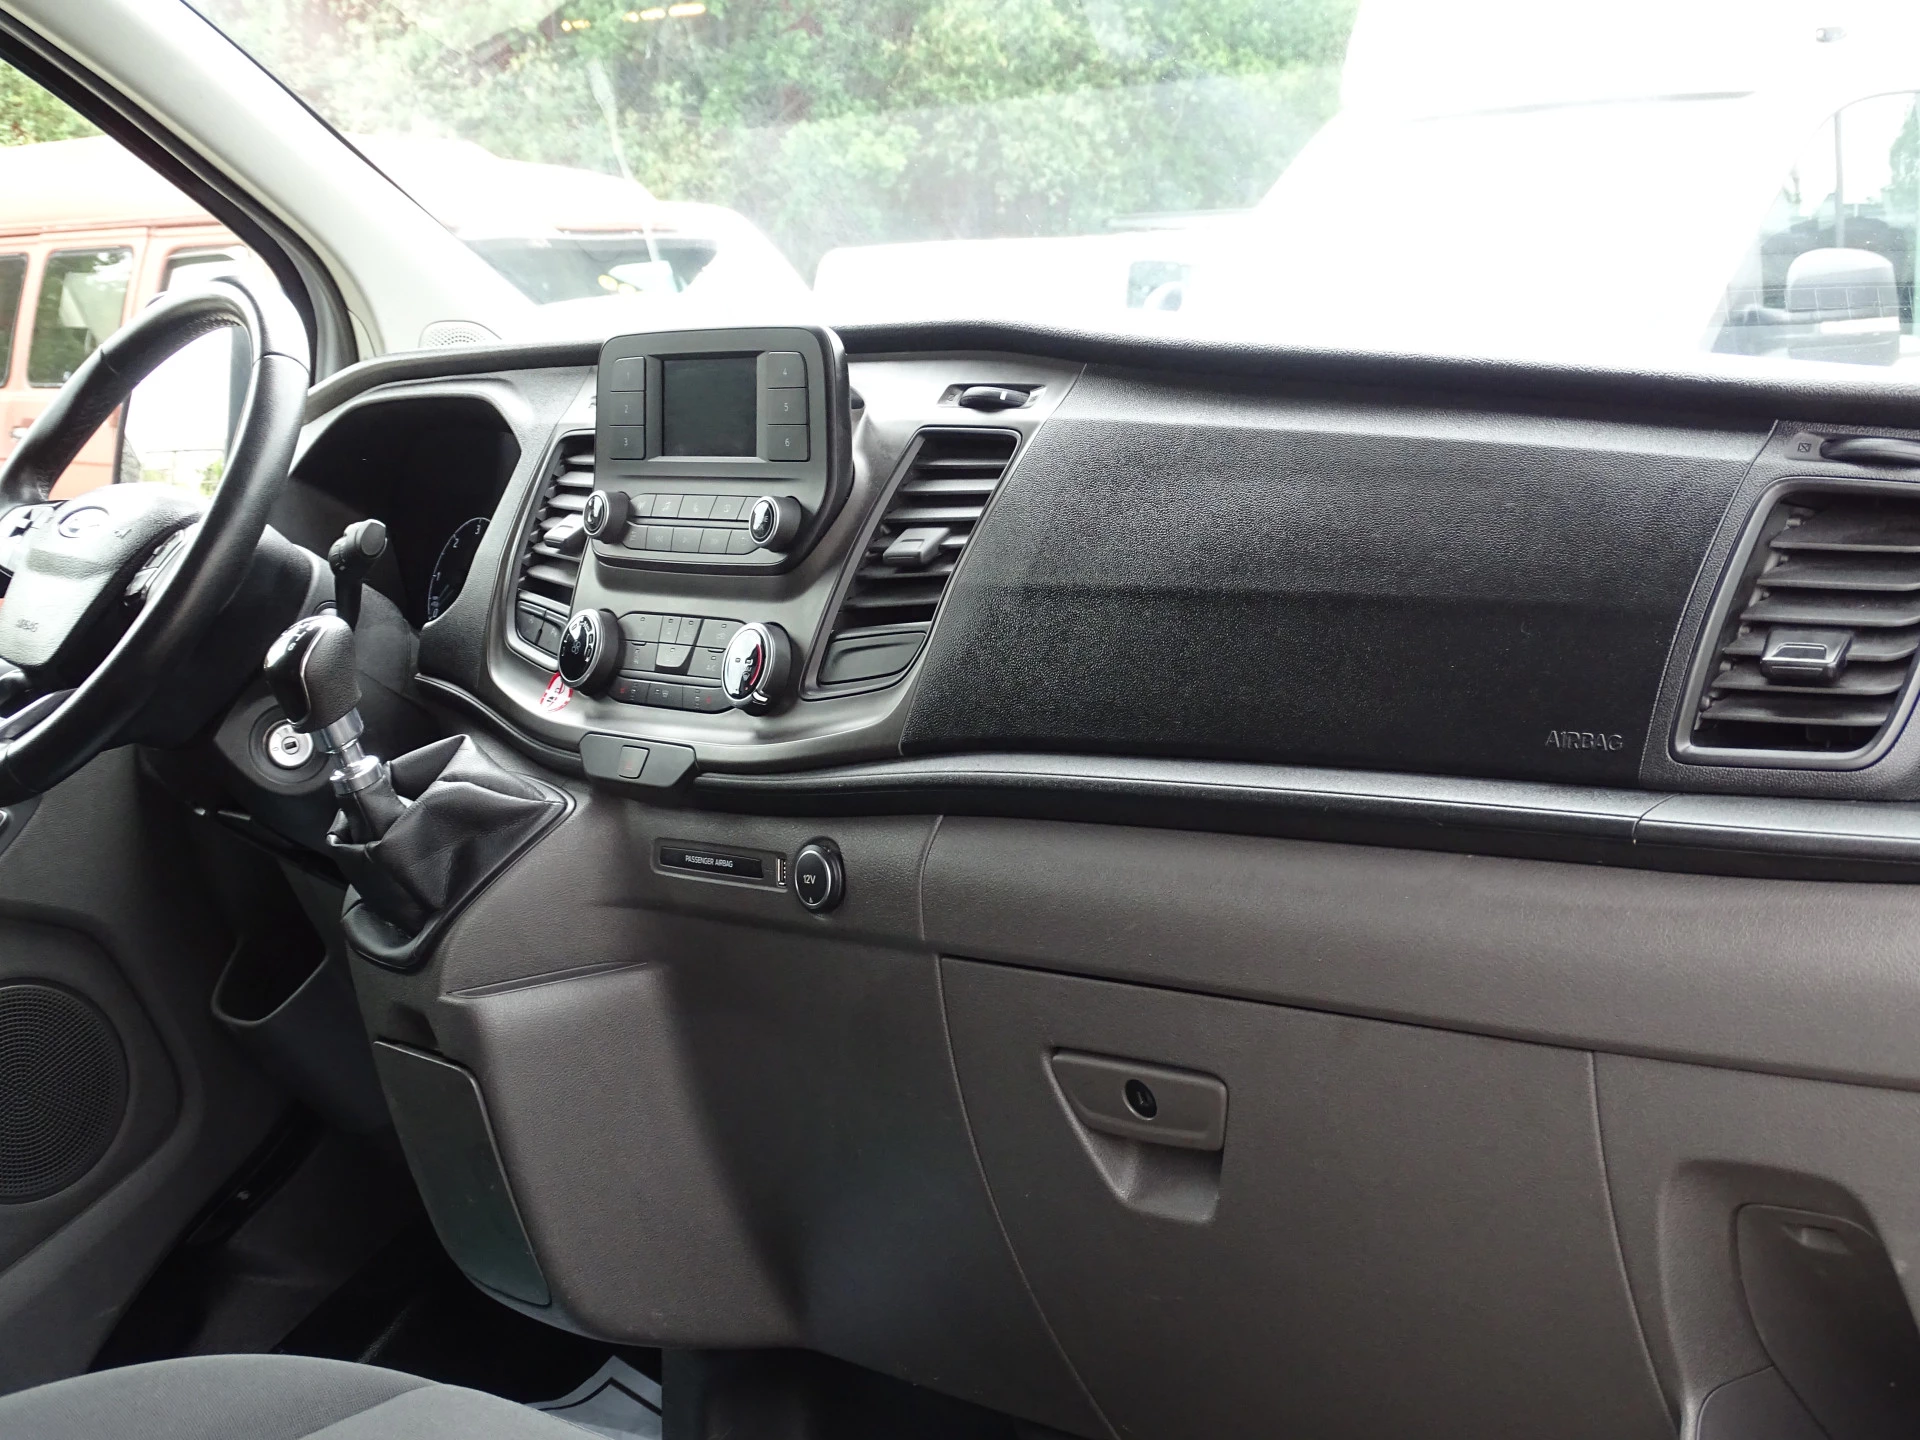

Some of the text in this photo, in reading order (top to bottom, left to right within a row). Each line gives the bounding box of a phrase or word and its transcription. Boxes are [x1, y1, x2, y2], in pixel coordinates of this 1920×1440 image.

[784, 402, 790, 412] 5
[623, 437, 629, 447] 3
[784, 438, 791, 448] 6
[474, 524, 482, 535] 3
[453, 538, 460, 548] 2
[1545, 730, 1623, 751] AIRBAG
[685, 854, 734, 868] PASSENGER AIRBAG
[803, 874, 816, 885] 12V
